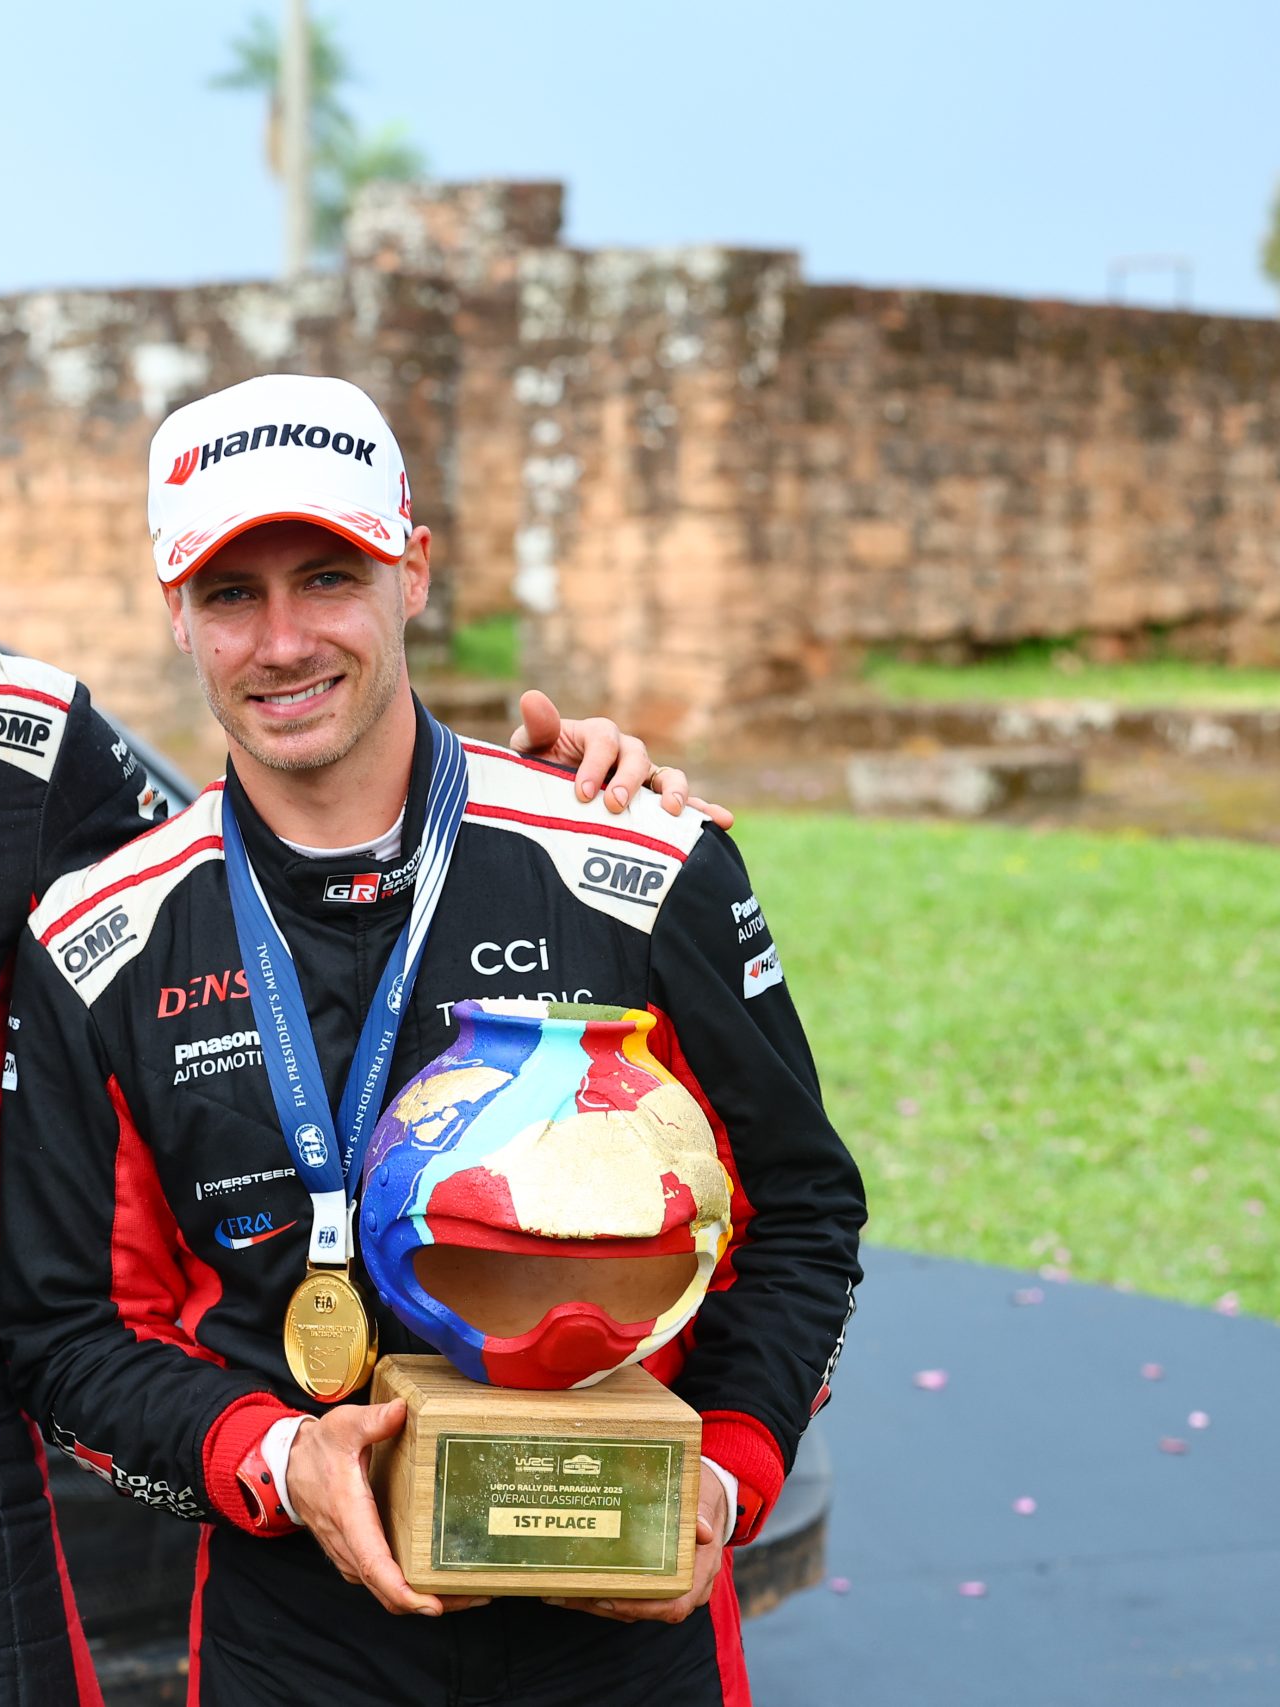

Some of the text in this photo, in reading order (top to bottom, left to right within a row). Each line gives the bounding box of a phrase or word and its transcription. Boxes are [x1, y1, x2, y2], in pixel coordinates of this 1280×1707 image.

[381, 874, 417, 899] Racin
[582, 853, 664, 900] OMP
[326, 881, 377, 901] GR
[62, 910, 131, 977] OMP
[157, 968, 251, 1019] DENS
[257, 941, 307, 1108] FIA PRESIDENT'S MEDAL
[175, 1030, 261, 1065] Pnason
[379, 1030, 394, 1053] FIA
[342, 1146, 355, 1178] MED
[203, 1168, 296, 1192] OVERSTEER
[491, 1493, 621, 1506] OVERALL CLASSIFICATION
[517, 1484, 542, 1492] RALLY
[559, 1485, 601, 1493] PARAGUAY
[603, 1486, 623, 1494] 2025
[513, 1515, 597, 1529] 1ST PLACE
